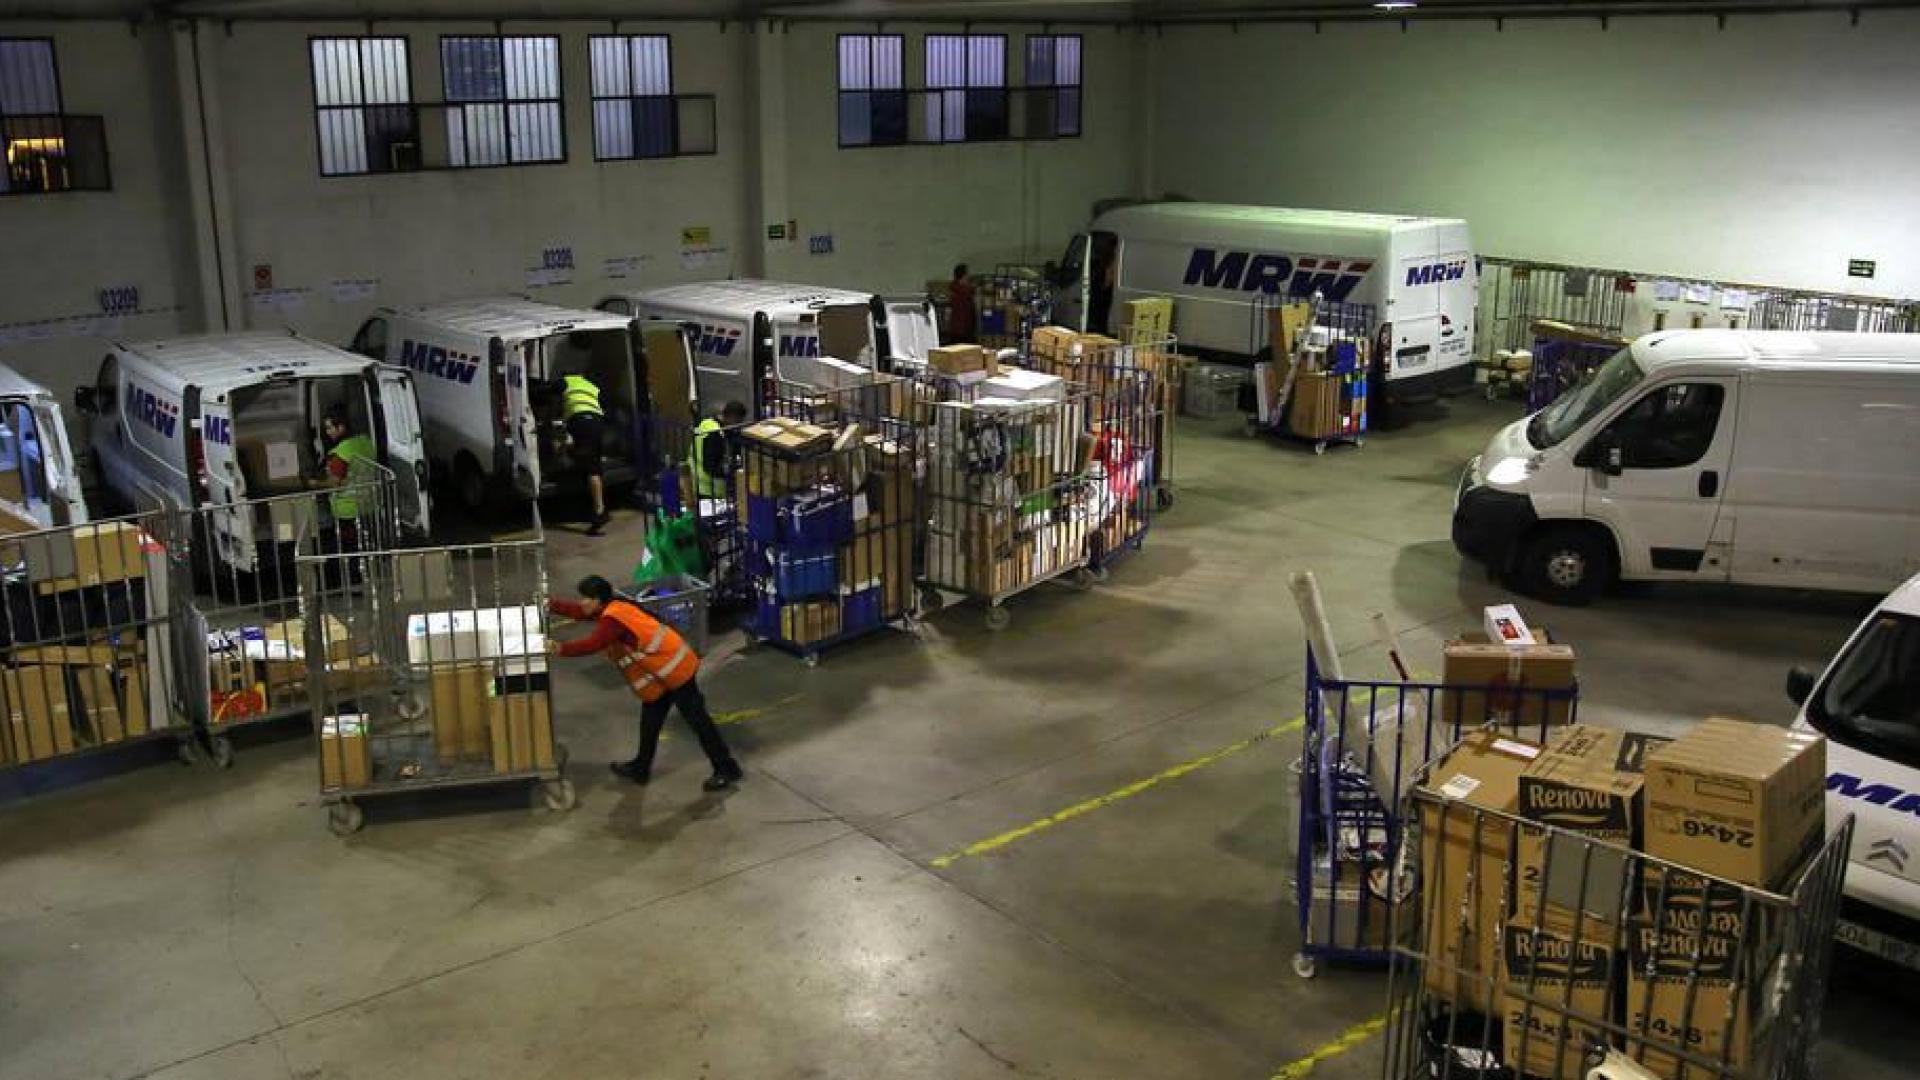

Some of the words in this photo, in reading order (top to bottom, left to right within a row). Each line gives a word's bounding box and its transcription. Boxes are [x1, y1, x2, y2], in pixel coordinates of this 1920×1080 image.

[1183, 248, 1376, 301] MRW
[1406, 261, 1465, 287] MRW
[402, 339, 480, 385] MRW
[127, 382, 179, 439] MRW
[1529, 783, 1611, 809] Renova
[1682, 820, 1754, 848] 24x6
